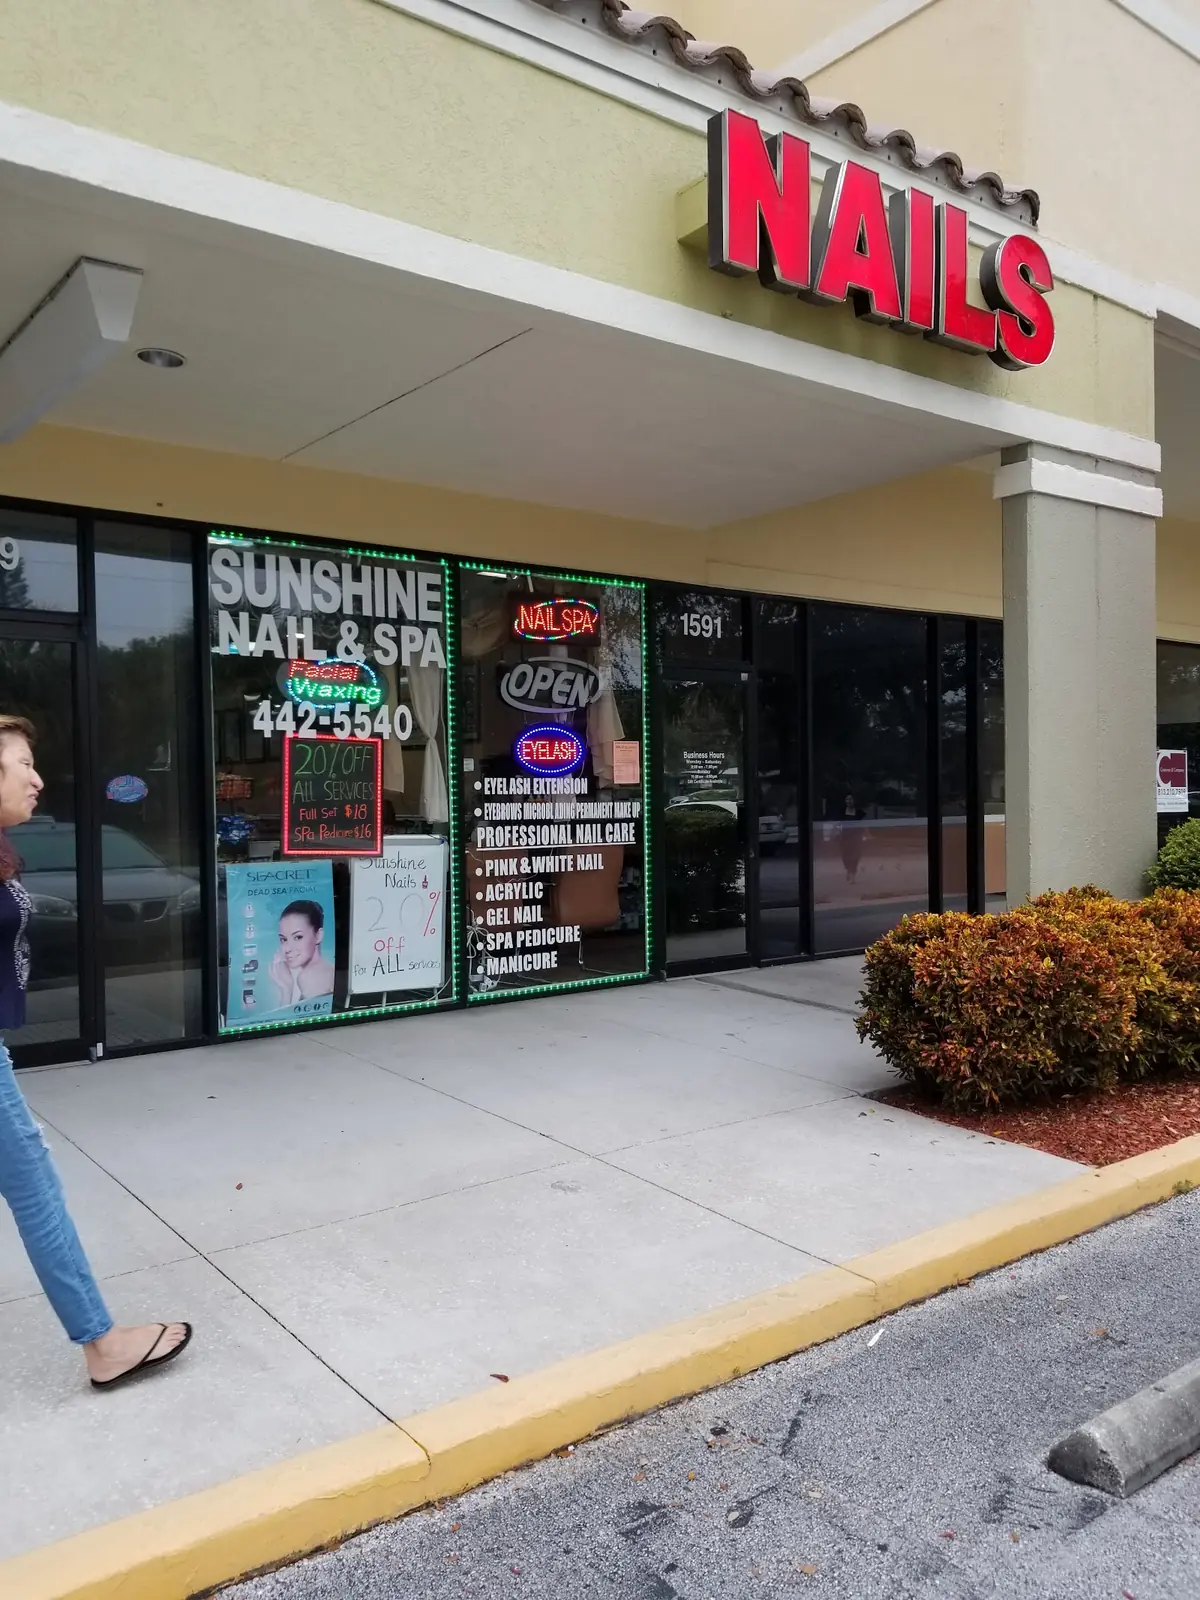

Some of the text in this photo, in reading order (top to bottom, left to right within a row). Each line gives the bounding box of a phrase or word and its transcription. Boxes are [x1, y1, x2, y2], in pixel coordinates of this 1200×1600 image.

[708, 108, 1055, 370] NAILS
[211, 548, 443, 622] SUNSHINE
[520, 605, 594, 632] NAIL SPA
[680, 612, 722, 639] 1591
[218, 610, 447, 668] NAIL & SPA
[289, 661, 359, 681] Facial
[291, 678, 381, 705] Waxing
[508, 663, 595, 708] OPEN
[253, 700, 413, 741] 442-5540
[294, 743, 373, 778] 20% OFF
[522, 741, 577, 760] EYELASH
[683, 751, 725, 759] Business Hours
[293, 780, 375, 804] ALL SERVICES
[484, 778, 588, 795] EYELASH EXTENSION
[300, 808, 317, 821] Full
[345, 803, 367, 819] $18
[484, 803, 522, 821] EYEBROWS
[576, 802, 613, 819] PERMANENT
[614, 802, 631, 818] MAKE
[632, 802, 640, 818] UP
[354, 824, 372, 839] $16
[477, 822, 636, 847] PROFESSIONAL NAIL CARE
[247, 869, 317, 882] SEACRET
[485, 853, 604, 876] PINK & WHITE NAIL
[248, 886, 317, 896] DEAD SEA FACIAL
[385, 873, 417, 889] Nails
[485, 881, 544, 902] ACRYLIC
[486, 904, 543, 926] GEL NAIL
[486, 925, 581, 951] SPA PEDICURE
[354, 964, 367, 976] for
[373, 953, 404, 977] ALL
[486, 951, 558, 976] MANICURE
